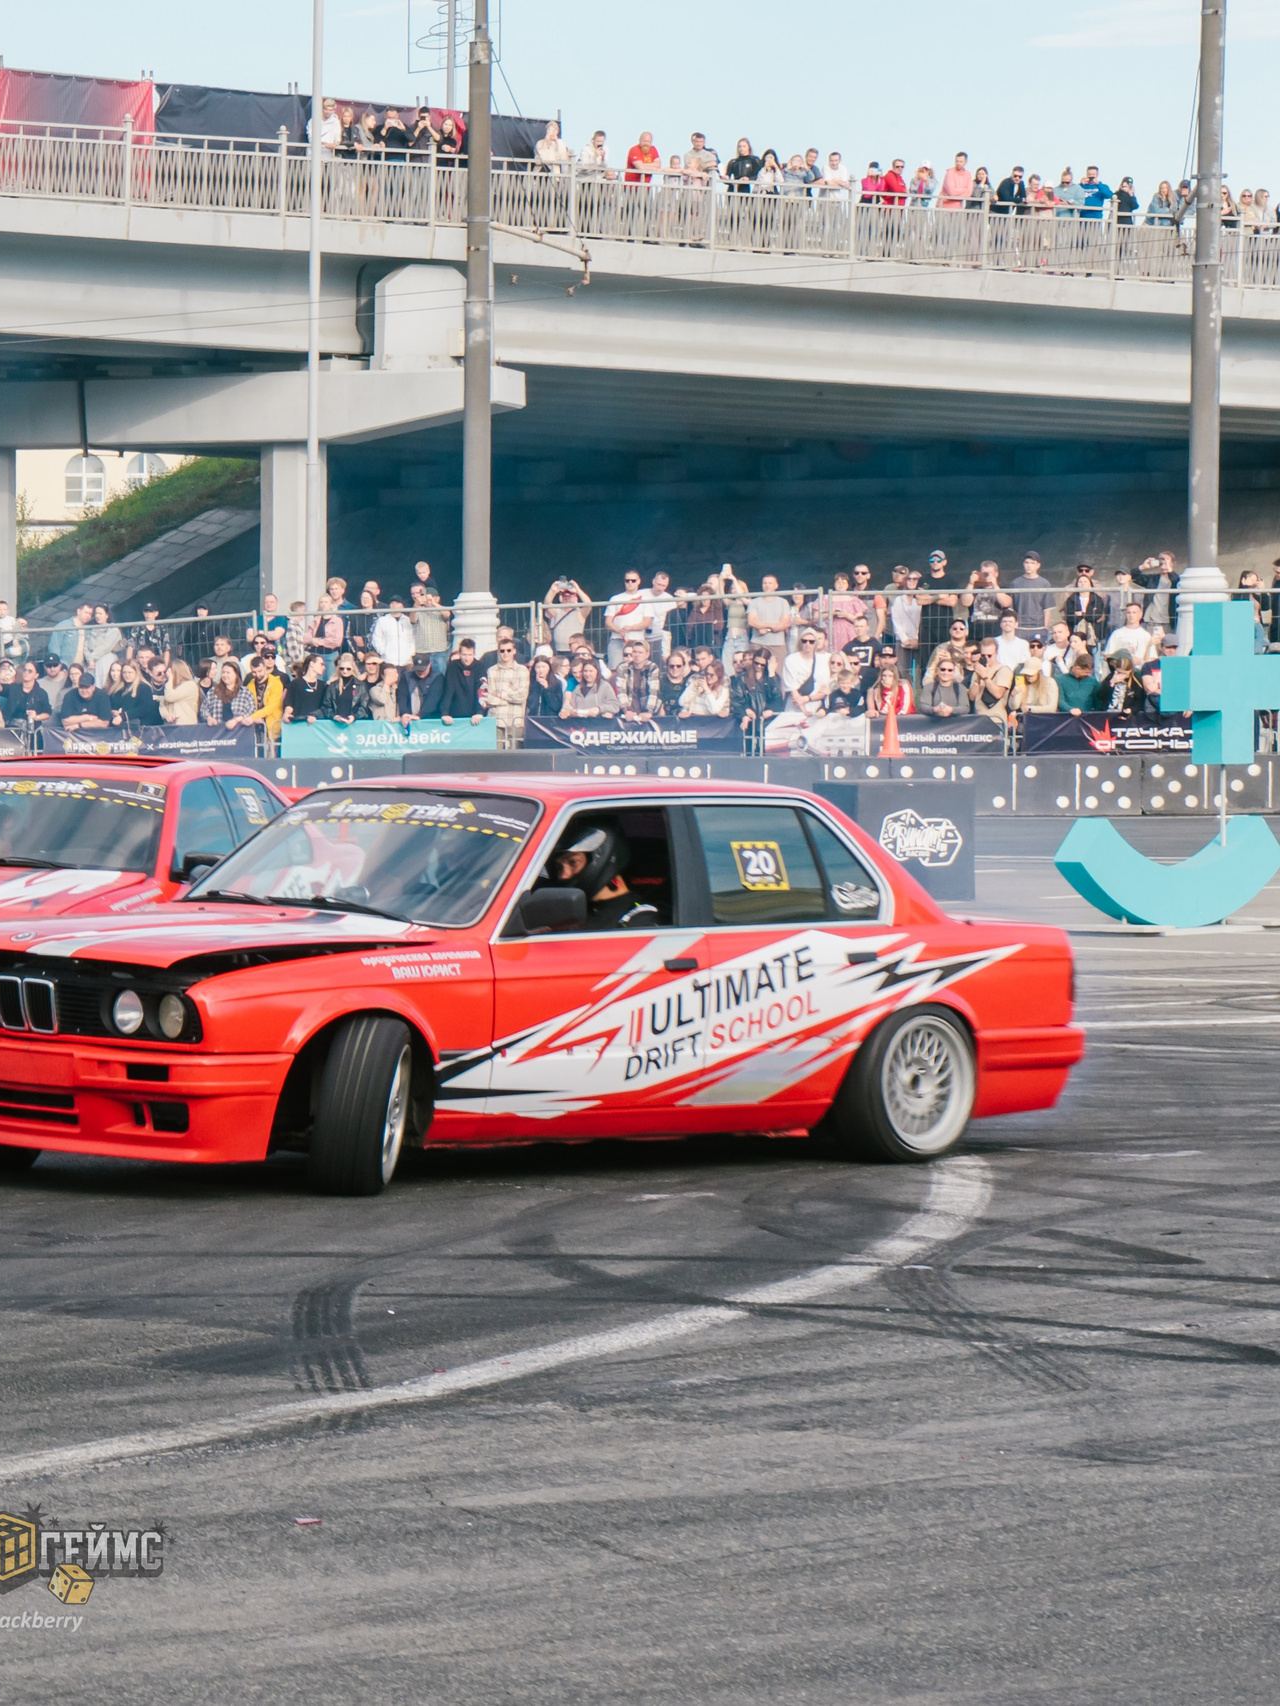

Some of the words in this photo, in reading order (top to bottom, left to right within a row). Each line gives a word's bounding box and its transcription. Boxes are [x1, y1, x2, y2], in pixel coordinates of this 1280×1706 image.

[355, 729, 451, 747] эдельвейс
[938, 734, 993, 743] КОМПЛЕКС
[921, 746, 958, 755] Пышма
[741, 850, 776, 875] 20
[391, 966, 420, 980] ВАШ
[420, 963, 461, 977] ЮРИСТ
[651, 946, 815, 1035] ULTIMATE
[624, 1031, 702, 1081] DRIFT
[709, 990, 820, 1050] SCHOOL
